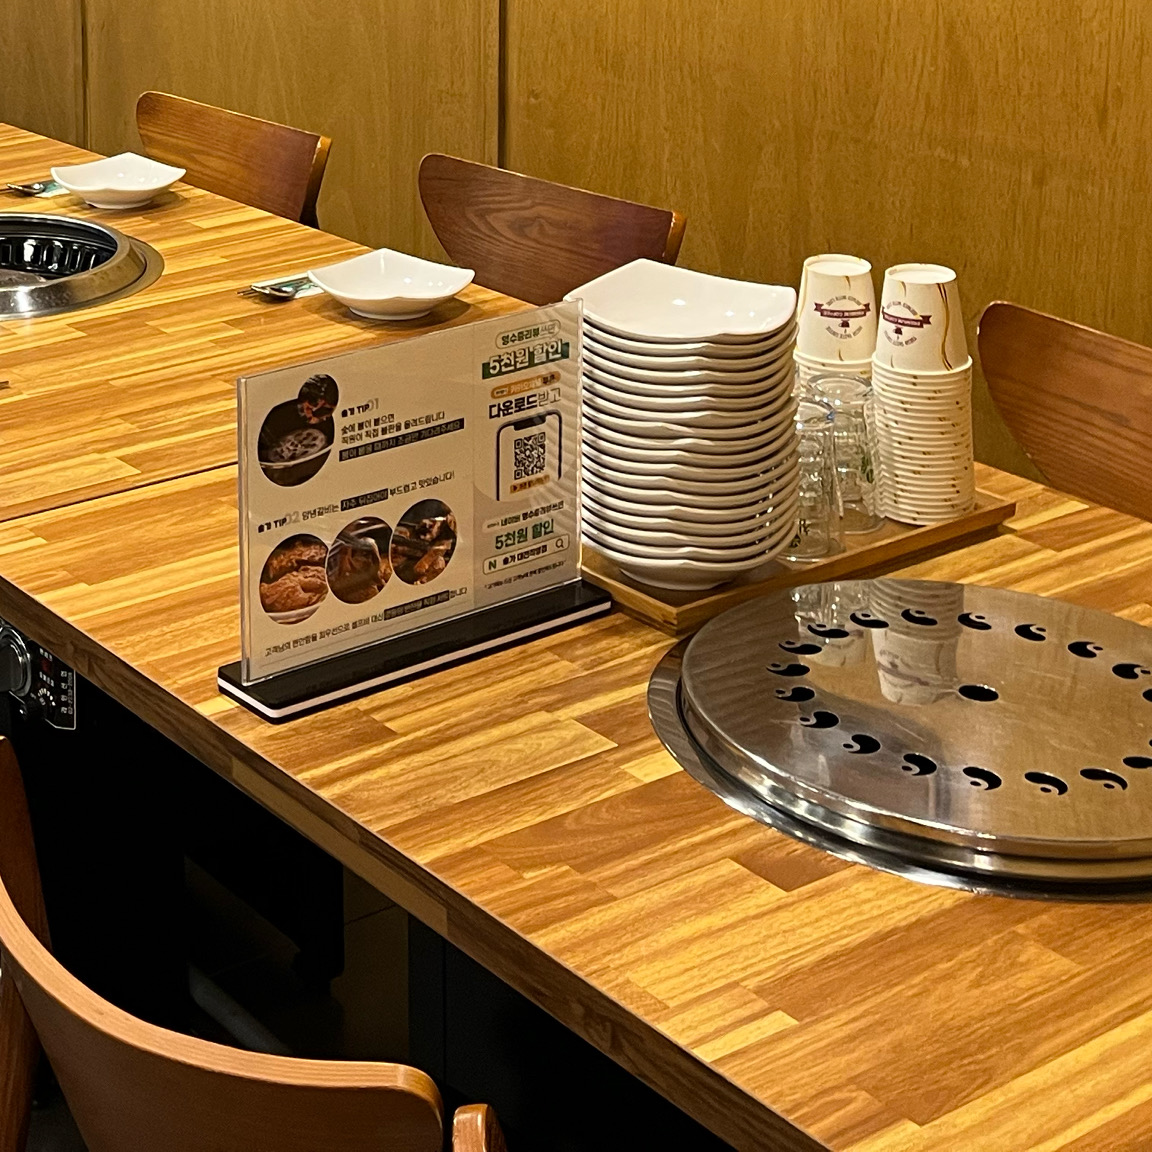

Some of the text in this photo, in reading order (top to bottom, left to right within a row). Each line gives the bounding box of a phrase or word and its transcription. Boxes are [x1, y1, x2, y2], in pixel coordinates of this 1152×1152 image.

[489, 339, 562, 374] 5천원 할인
[489, 387, 561, 419] 다운로드받고
[495, 518, 555, 550] 5천원 할인
